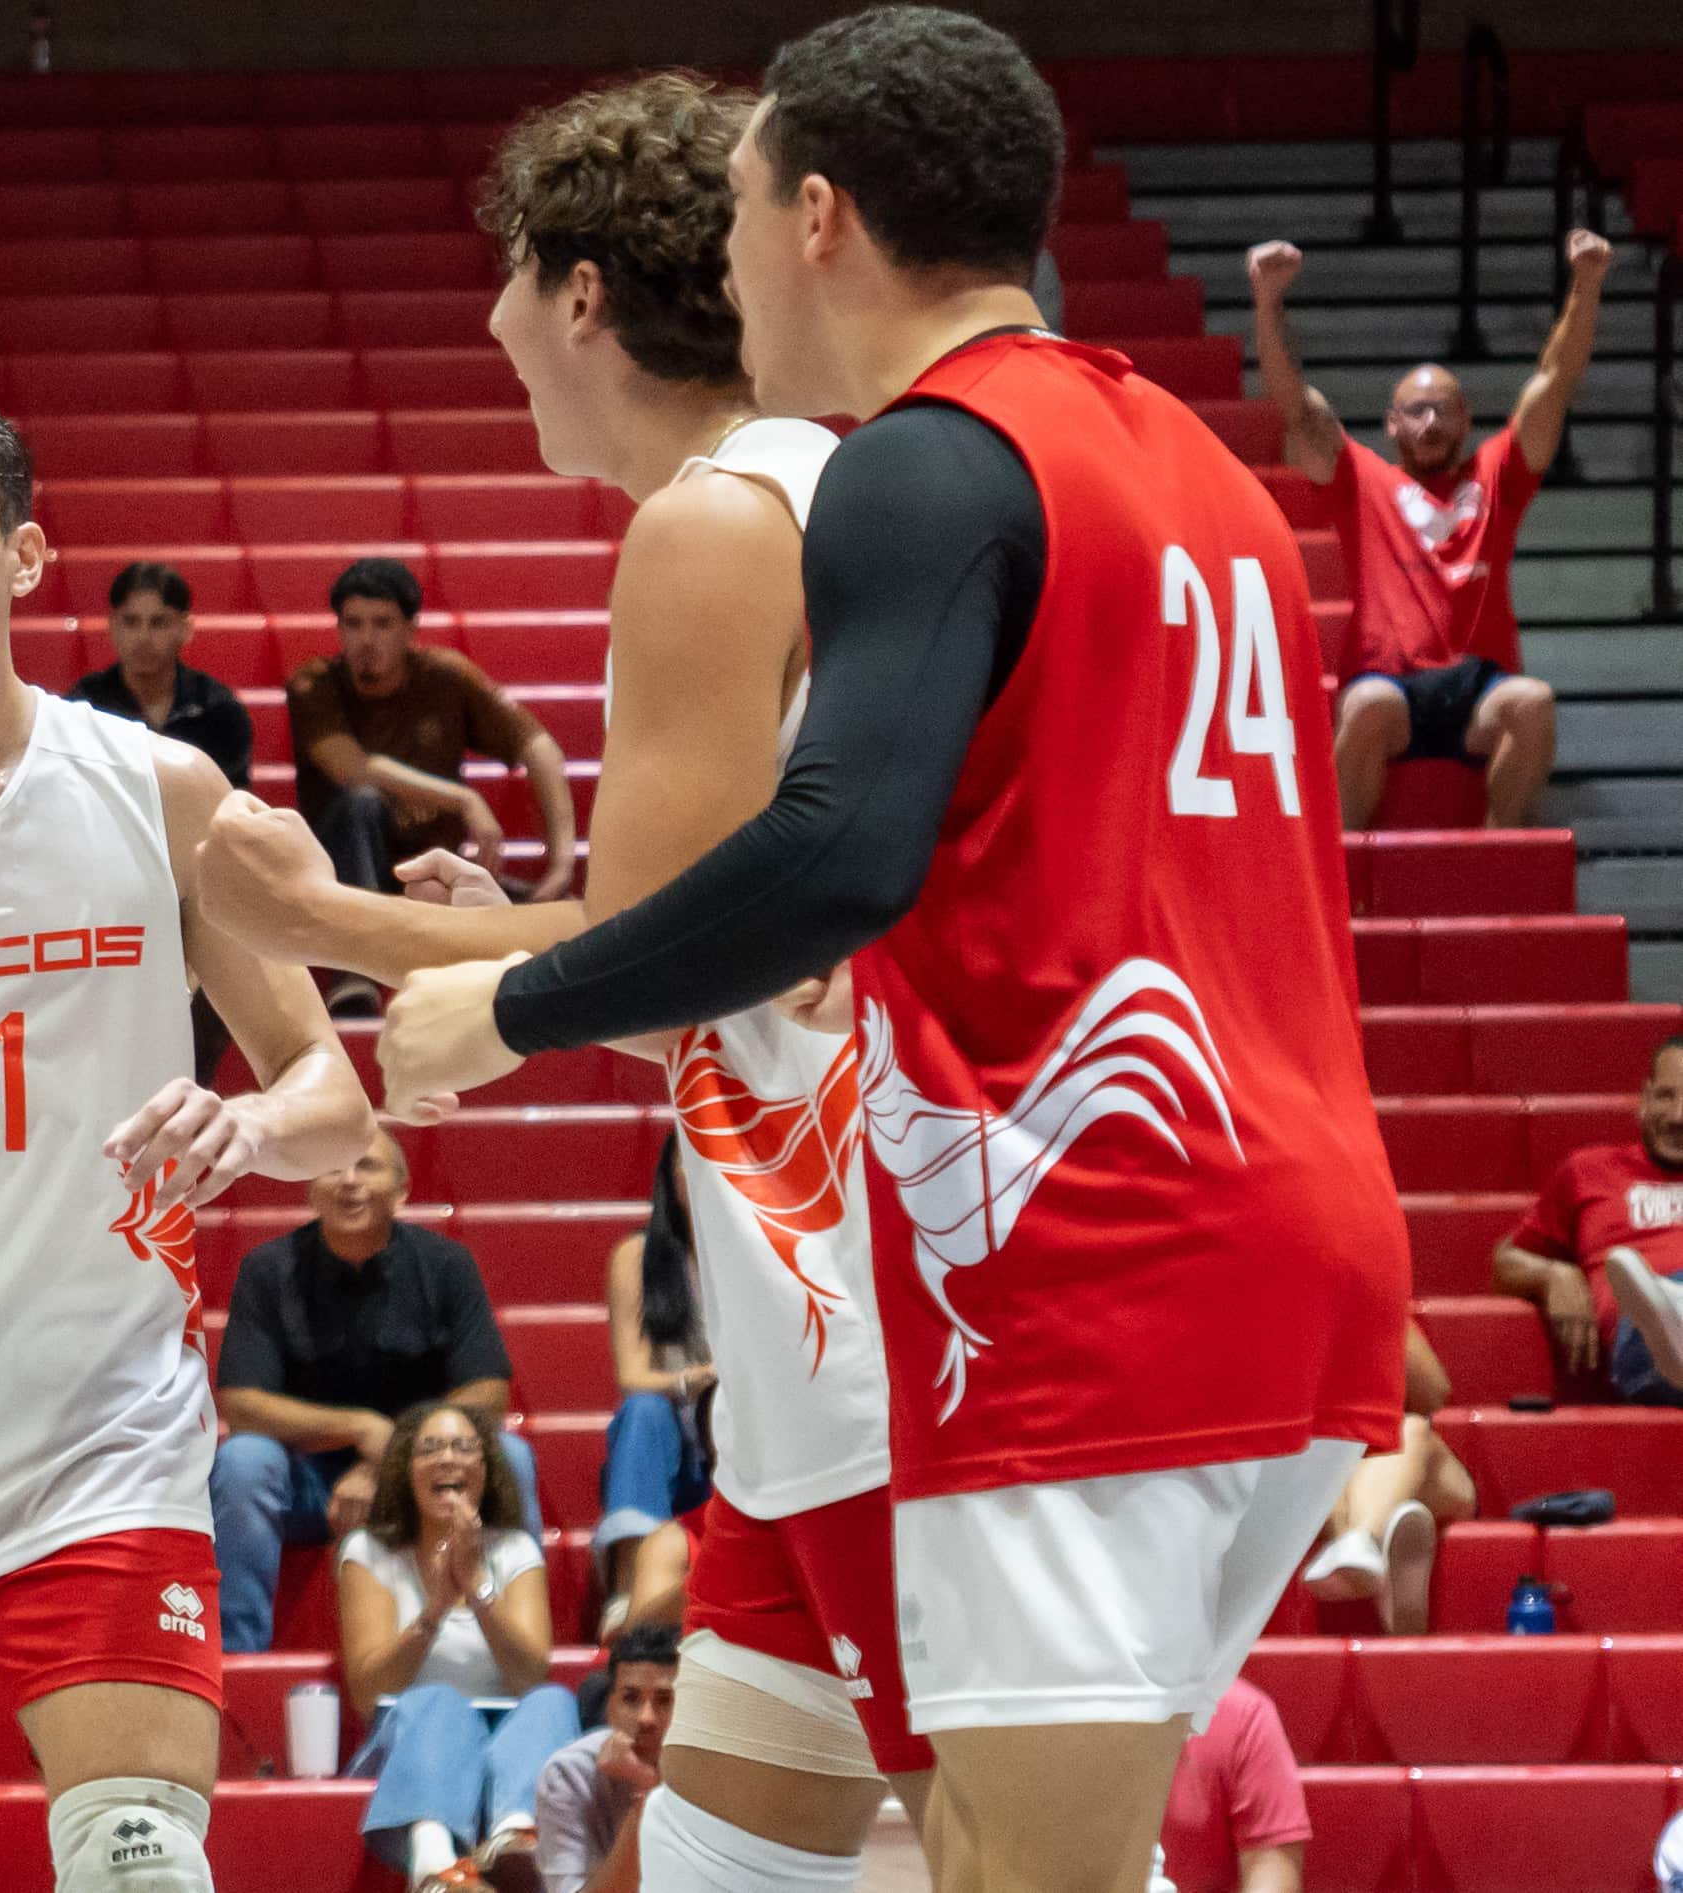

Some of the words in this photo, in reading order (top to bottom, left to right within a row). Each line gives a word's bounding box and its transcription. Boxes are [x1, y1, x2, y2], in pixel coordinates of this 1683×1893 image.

[1160, 542, 1302, 818] 24
[159, 1613, 206, 1642] errea
[111, 1843, 163, 1863] errea
